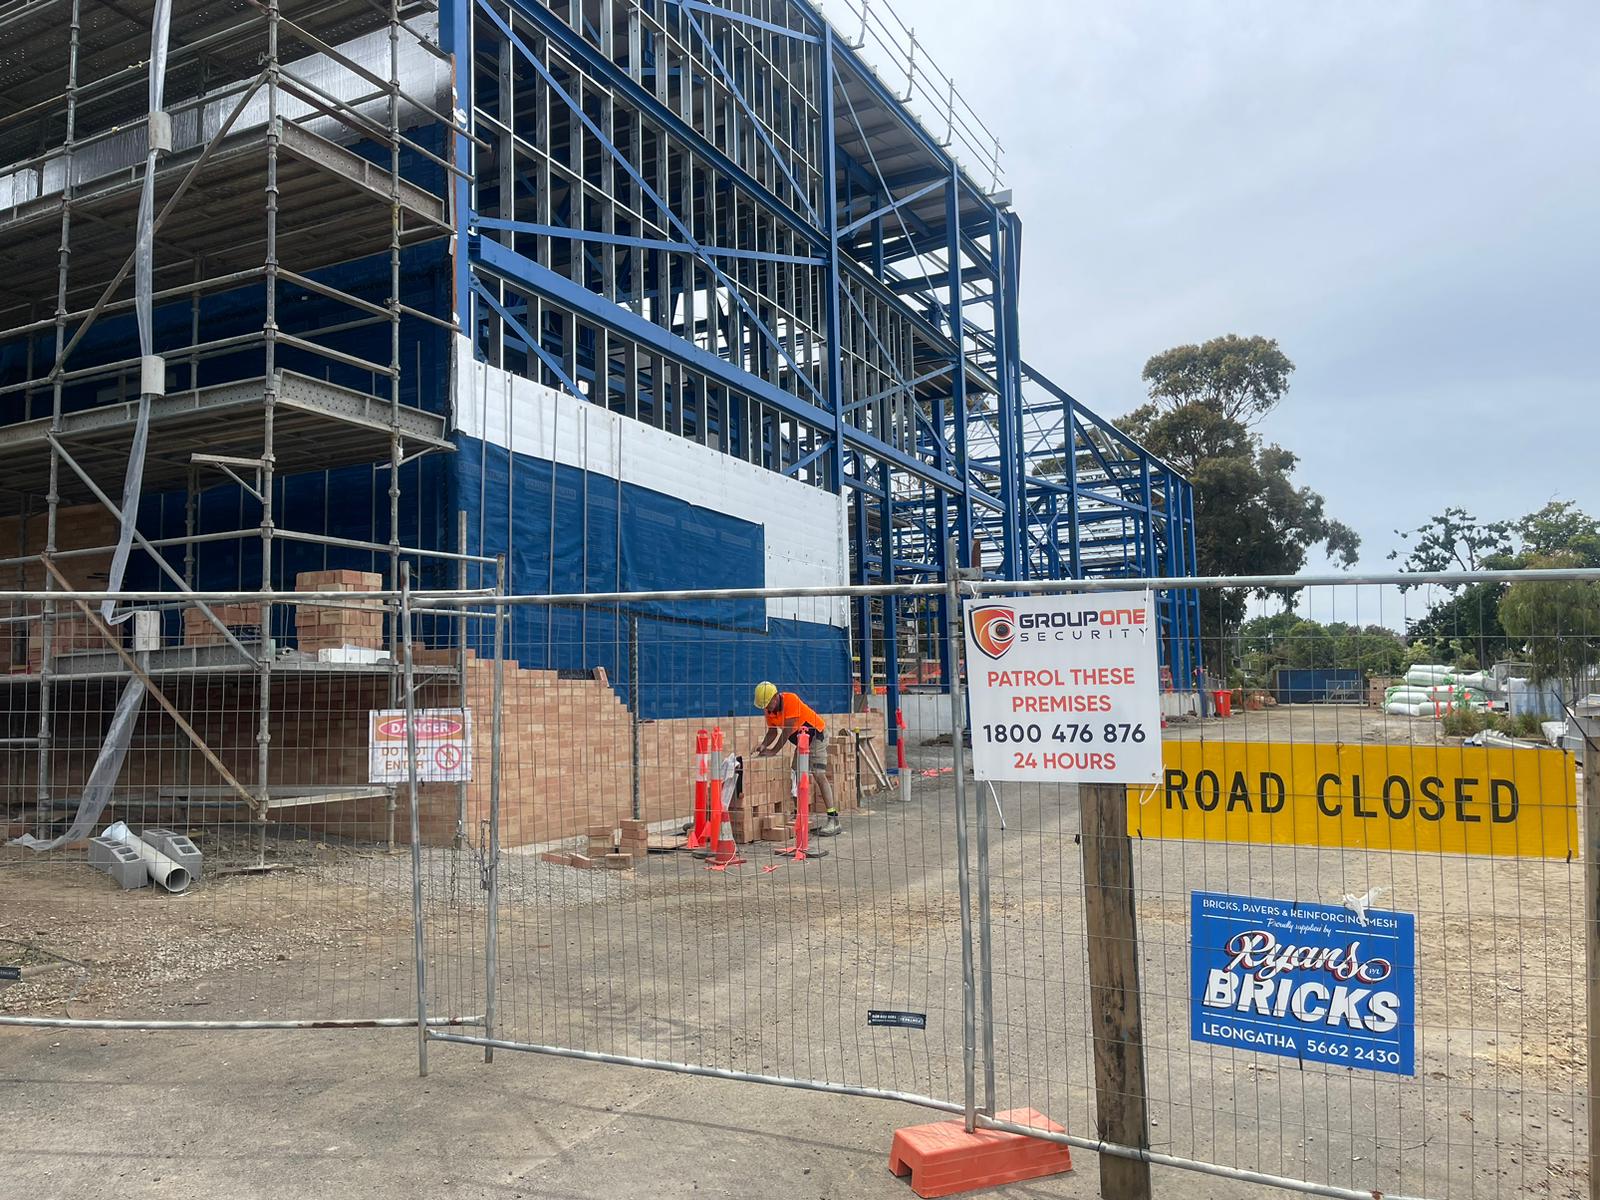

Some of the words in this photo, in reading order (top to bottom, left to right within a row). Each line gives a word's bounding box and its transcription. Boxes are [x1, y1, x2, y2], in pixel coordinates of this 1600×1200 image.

[1019, 608, 1146, 628] GROUPONE
[1020, 628, 1148, 642] SECURITY
[987, 669, 1065, 688] PATROL
[1070, 667, 1135, 686] THESE
[1012, 695, 1112, 713] PREMISES
[983, 724, 1042, 744] 1800
[1051, 724, 1094, 744] 476
[1103, 723, 1146, 744] 876
[382, 746, 399, 756] DO
[1013, 752, 1038, 769] 24
[1043, 752, 1117, 770] HOURS
[386, 760, 424, 770] ENTR
[1164, 769, 1286, 814] ROAD
[1316, 773, 1520, 824] CLOSED
[1202, 898, 1241, 914] BRICKS,
[1242, 904, 1280, 917] PAVERS
[1281, 909, 1289, 918] &
[1365, 917, 1398, 929] MESH
[1322, 925, 1332, 937] by
[1226, 930, 1392, 981] Ryans
[1202, 968, 1401, 1034] BRICKS
[1202, 1022, 1297, 1051] LEONGATHA
[1306, 1038, 1349, 1058] 5662
[1354, 1046, 1400, 1065] 2430
